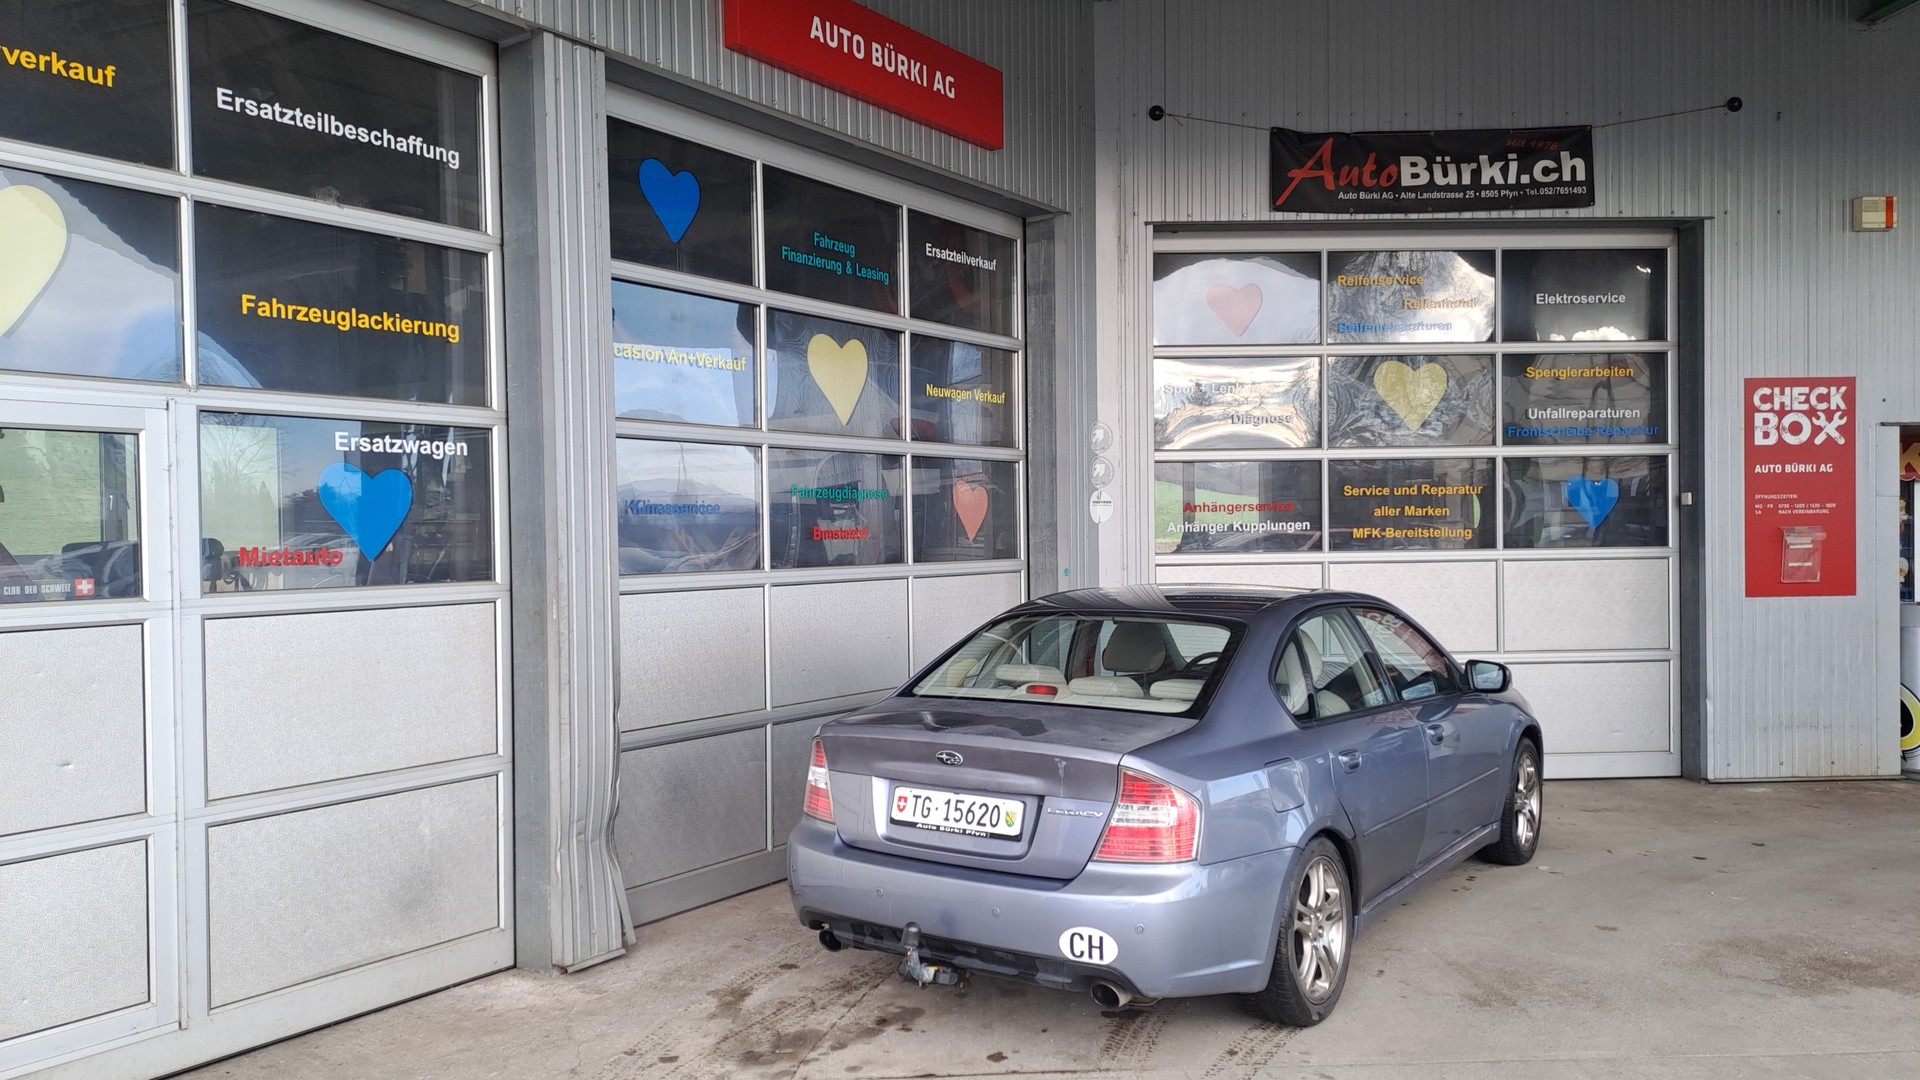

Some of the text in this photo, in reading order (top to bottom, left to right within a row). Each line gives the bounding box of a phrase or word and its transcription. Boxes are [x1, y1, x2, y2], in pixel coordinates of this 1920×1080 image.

[810, 16, 955, 99] AUTO BÜRKI AG
[0, 45, 116, 87] verkauf
[216, 86, 460, 170] Ersatzteilbeschaffung
[1527, 139, 1559, 151] 1976
[1338, 191, 1357, 199] Auto
[1360, 190, 1380, 199] Bürki
[1381, 191, 1394, 199] AG
[1400, 191, 1416, 199] Alte
[1417, 190, 1463, 199] Landstrasse
[1465, 190, 1475, 198] 25
[1481, 189, 1499, 198] 8505
[1501, 189, 1518, 199] Pfyn
[813, 231, 855, 258] Fahrzeug
[925, 242, 997, 271] Ersatzteilverkauf
[781, 245, 889, 286] Finanzierung & Leasing
[1337, 274, 1425, 287] Reifenservice
[1536, 292, 1626, 305] Elektroservice
[240, 293, 461, 343] Fahrzeuglackierung
[1526, 366, 1634, 380] Spenglerarbeiten
[926, 383, 1006, 404] Neuwagen Verkauf
[1753, 386, 1848, 411] CHECK
[1231, 413, 1294, 426] Diagnose
[1528, 408, 1641, 421] Unfallreparaturen
[1507, 426, 1592, 438] Frontscheibe
[1754, 411, 1848, 446] BOX
[334, 431, 469, 460] Ersatzwagen
[1754, 462, 1833, 474] AUTO BÜRKI AG
[791, 484, 889, 503] Fahrzeugdiagnose
[1343, 484, 1483, 497] Service und Reparatur
[1183, 502, 1295, 515] Anhängerservice
[1373, 505, 1450, 517] aller Marken
[1167, 520, 1311, 534] Anhänger Kupplungen
[1352, 527, 1473, 540] MFK-Bereitstellung
[239, 546, 344, 567] Mietauto
[3, 583, 71, 596] CLUB DER SCHWEIZ
[916, 822, 937, 831] Auto
[939, 825, 963, 834] Bürki
[1069, 932, 1105, 961] CH
